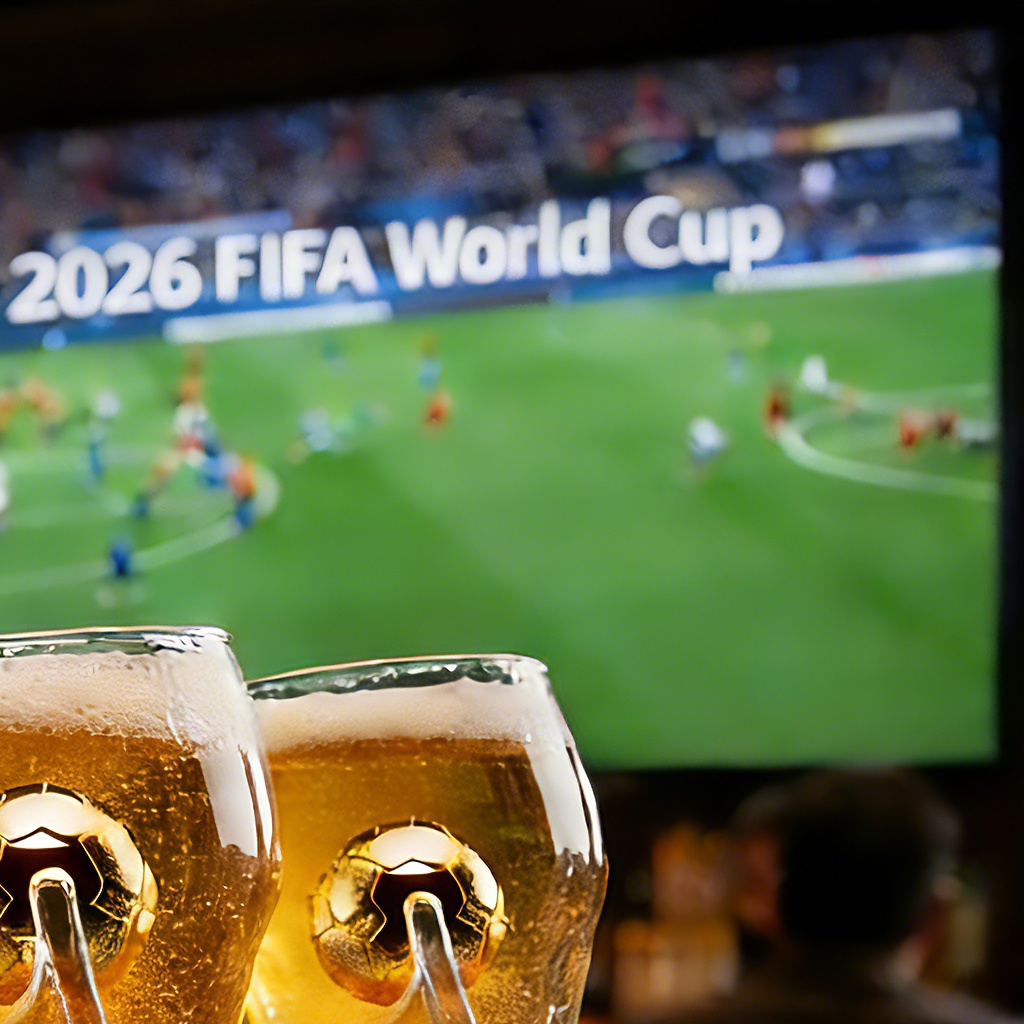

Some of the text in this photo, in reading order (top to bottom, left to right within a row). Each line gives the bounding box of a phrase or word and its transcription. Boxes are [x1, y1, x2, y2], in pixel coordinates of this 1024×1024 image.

[6, 193, 787, 324] 2026 FIFA World Cup
